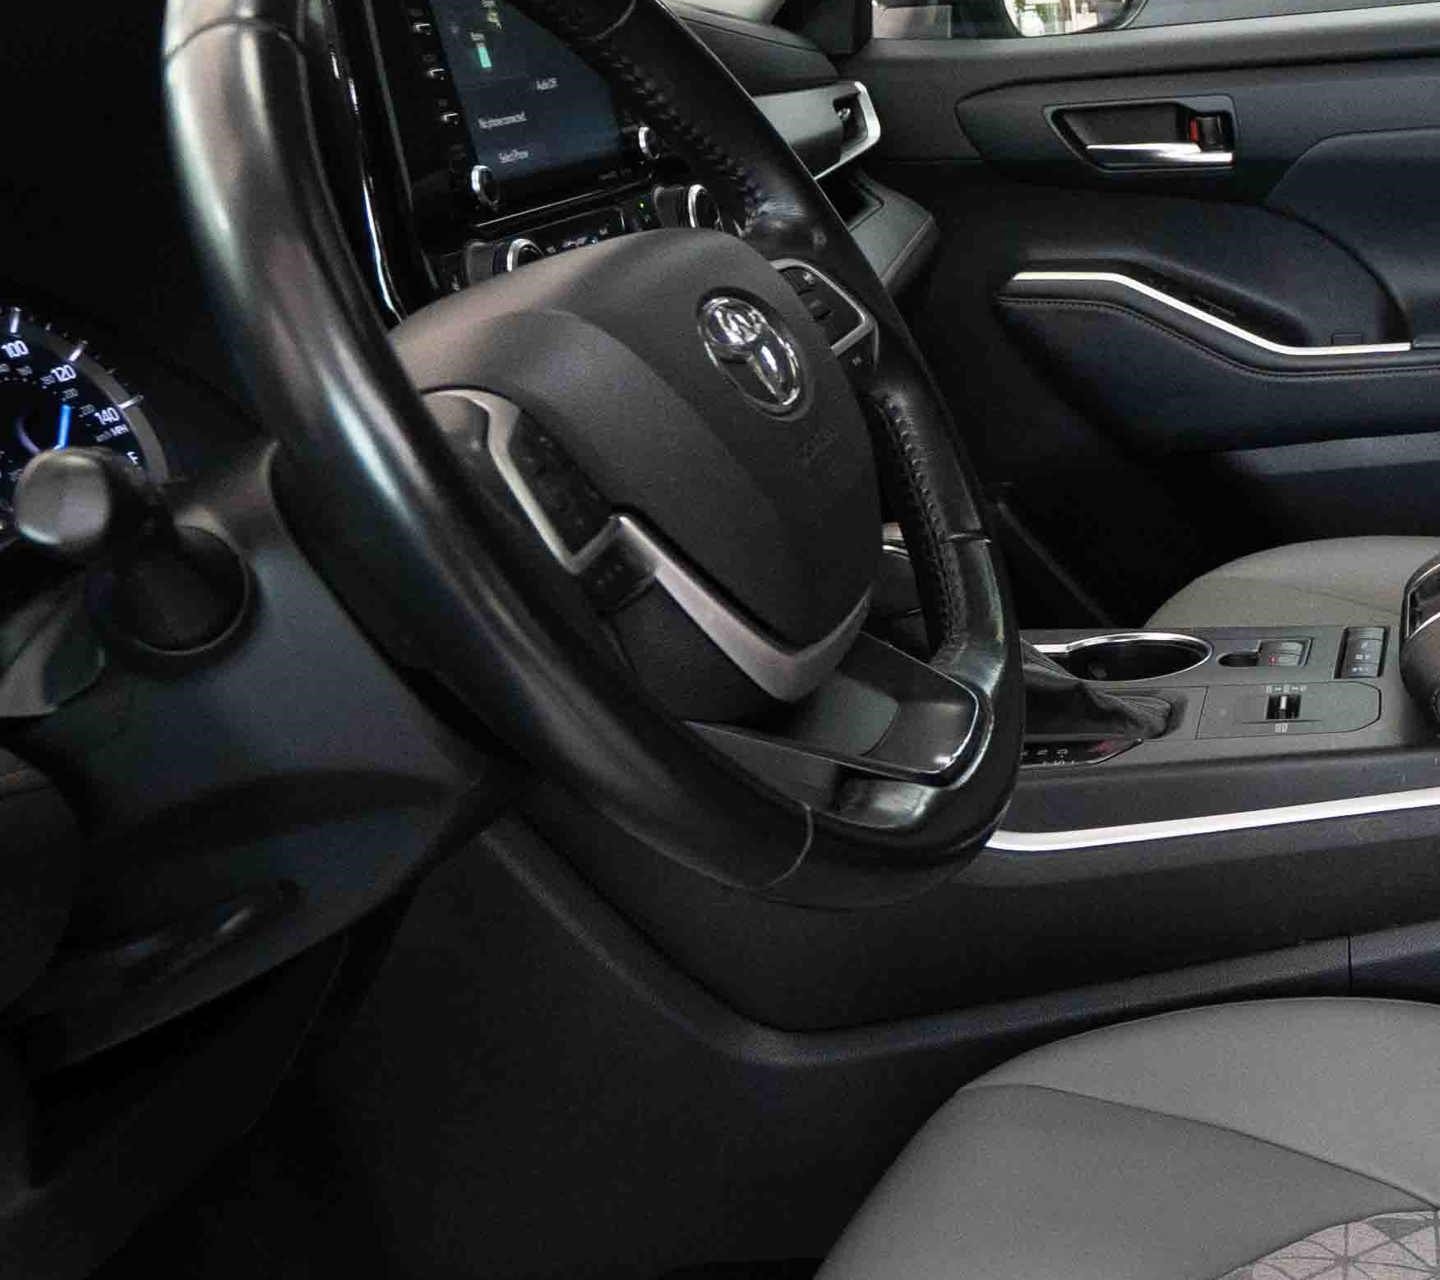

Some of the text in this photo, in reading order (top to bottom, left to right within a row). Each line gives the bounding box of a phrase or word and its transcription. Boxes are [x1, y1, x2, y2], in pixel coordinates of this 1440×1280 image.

[1, 340, 30, 358] 100
[52, 364, 76, 382] 120
[94, 407, 121, 425] 140
